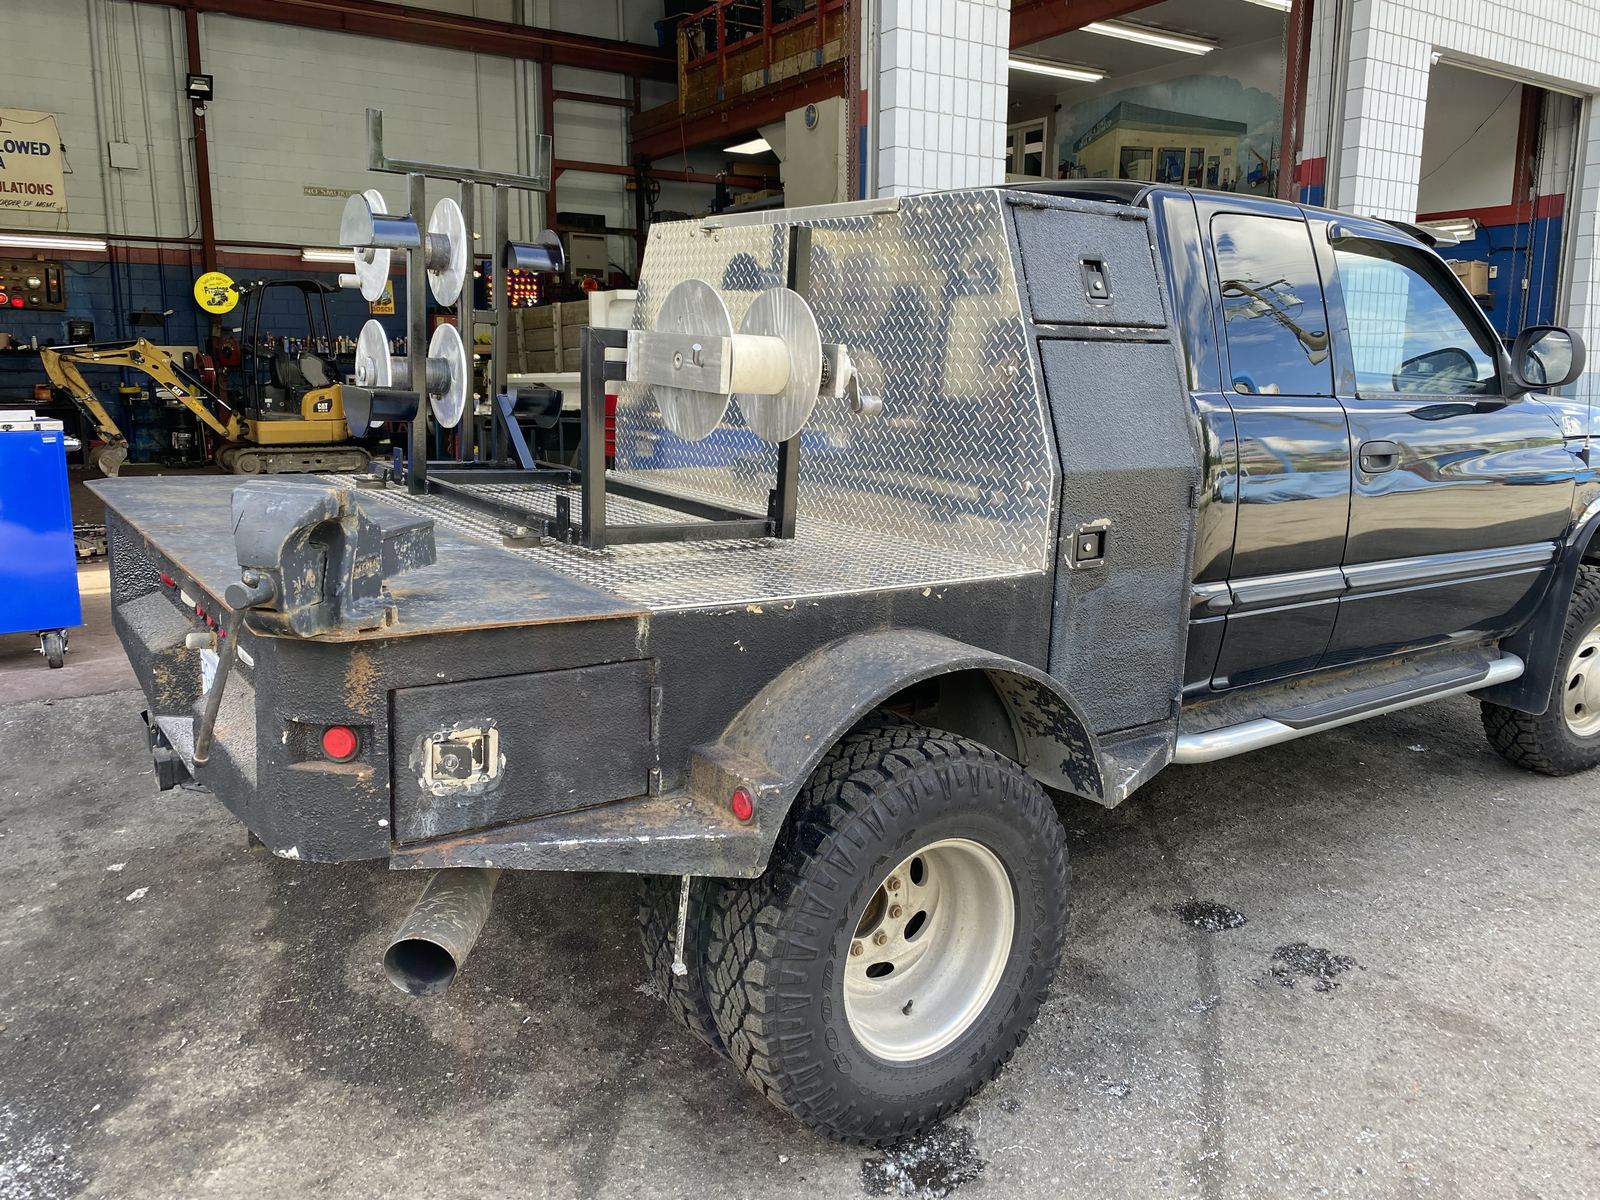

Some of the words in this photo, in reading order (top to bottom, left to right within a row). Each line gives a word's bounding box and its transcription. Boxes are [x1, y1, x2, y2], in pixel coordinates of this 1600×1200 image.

[0, 181, 54, 196] LATIONS
[171, 385, 184, 396] CAT
[317, 402, 328, 410] CAT
